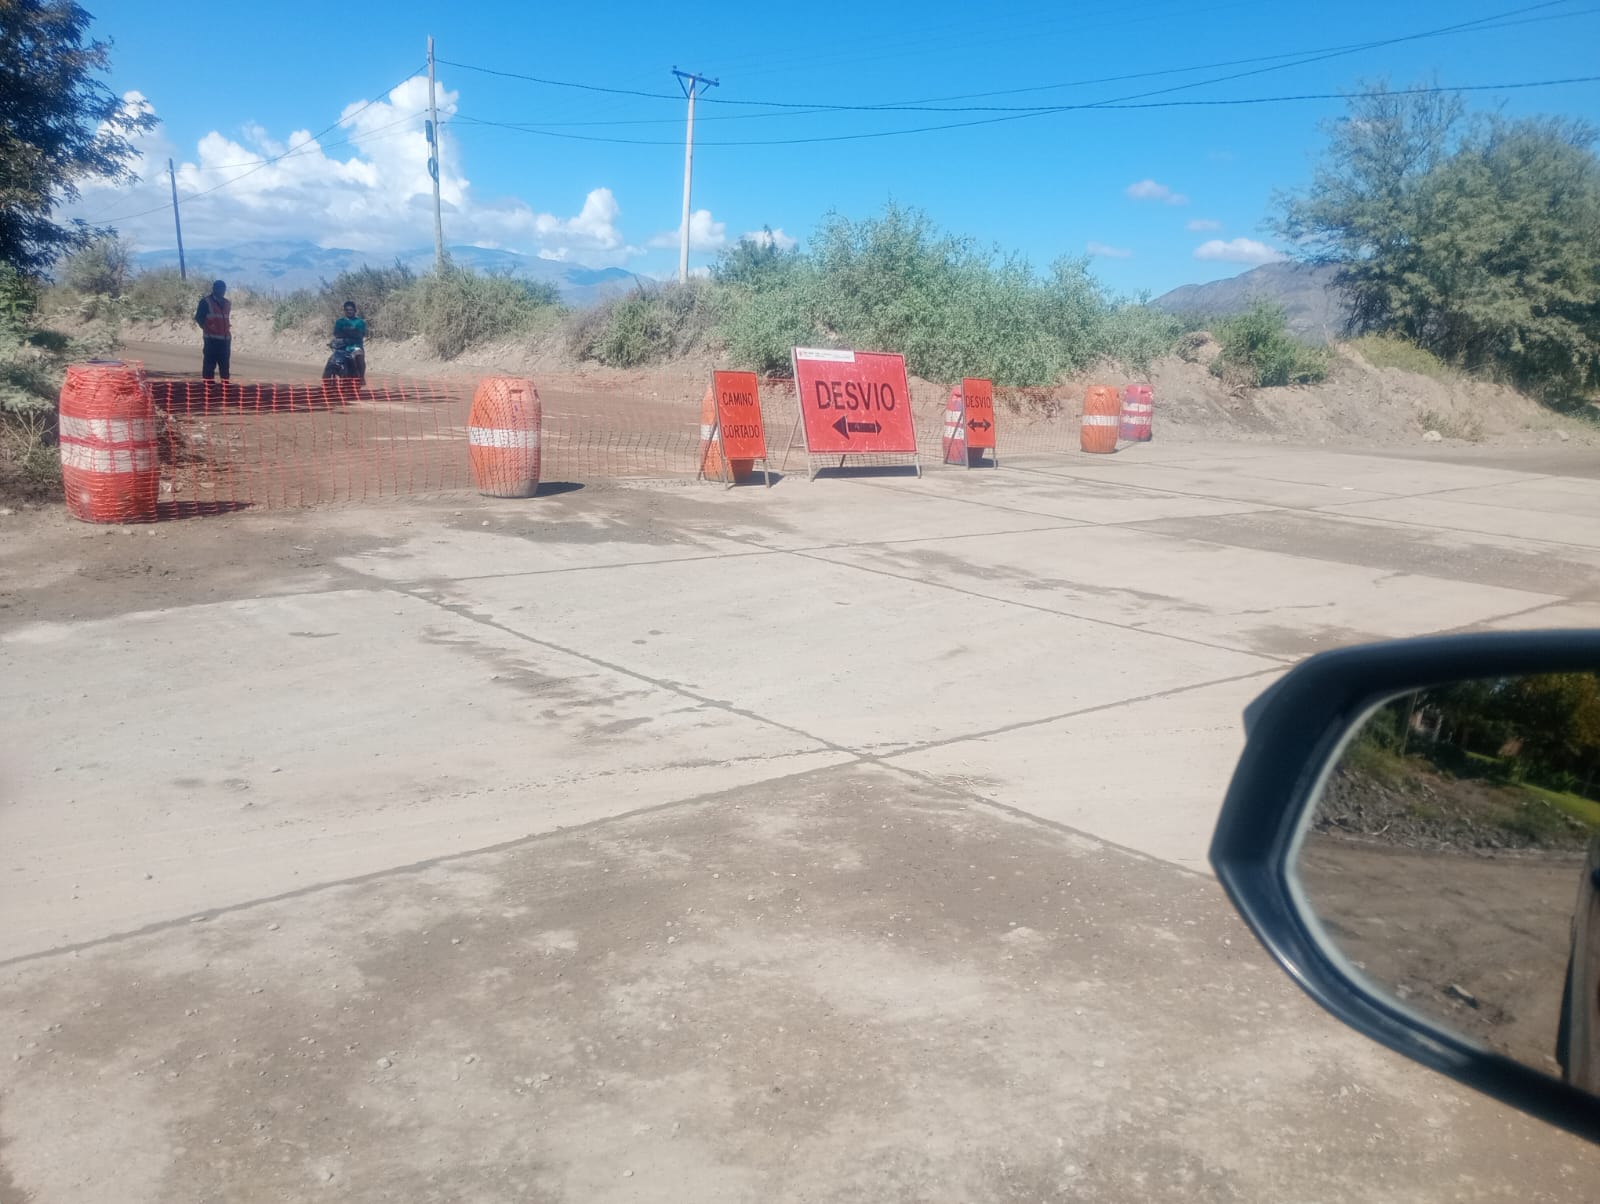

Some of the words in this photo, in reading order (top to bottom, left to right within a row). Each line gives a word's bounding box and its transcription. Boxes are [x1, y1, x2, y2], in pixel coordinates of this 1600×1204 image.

[722, 392, 754, 406] CAMINO
[815, 380, 895, 411] DESVIO
[965, 395, 991, 408] DESVIO
[723, 424, 760, 438] CORTADO
